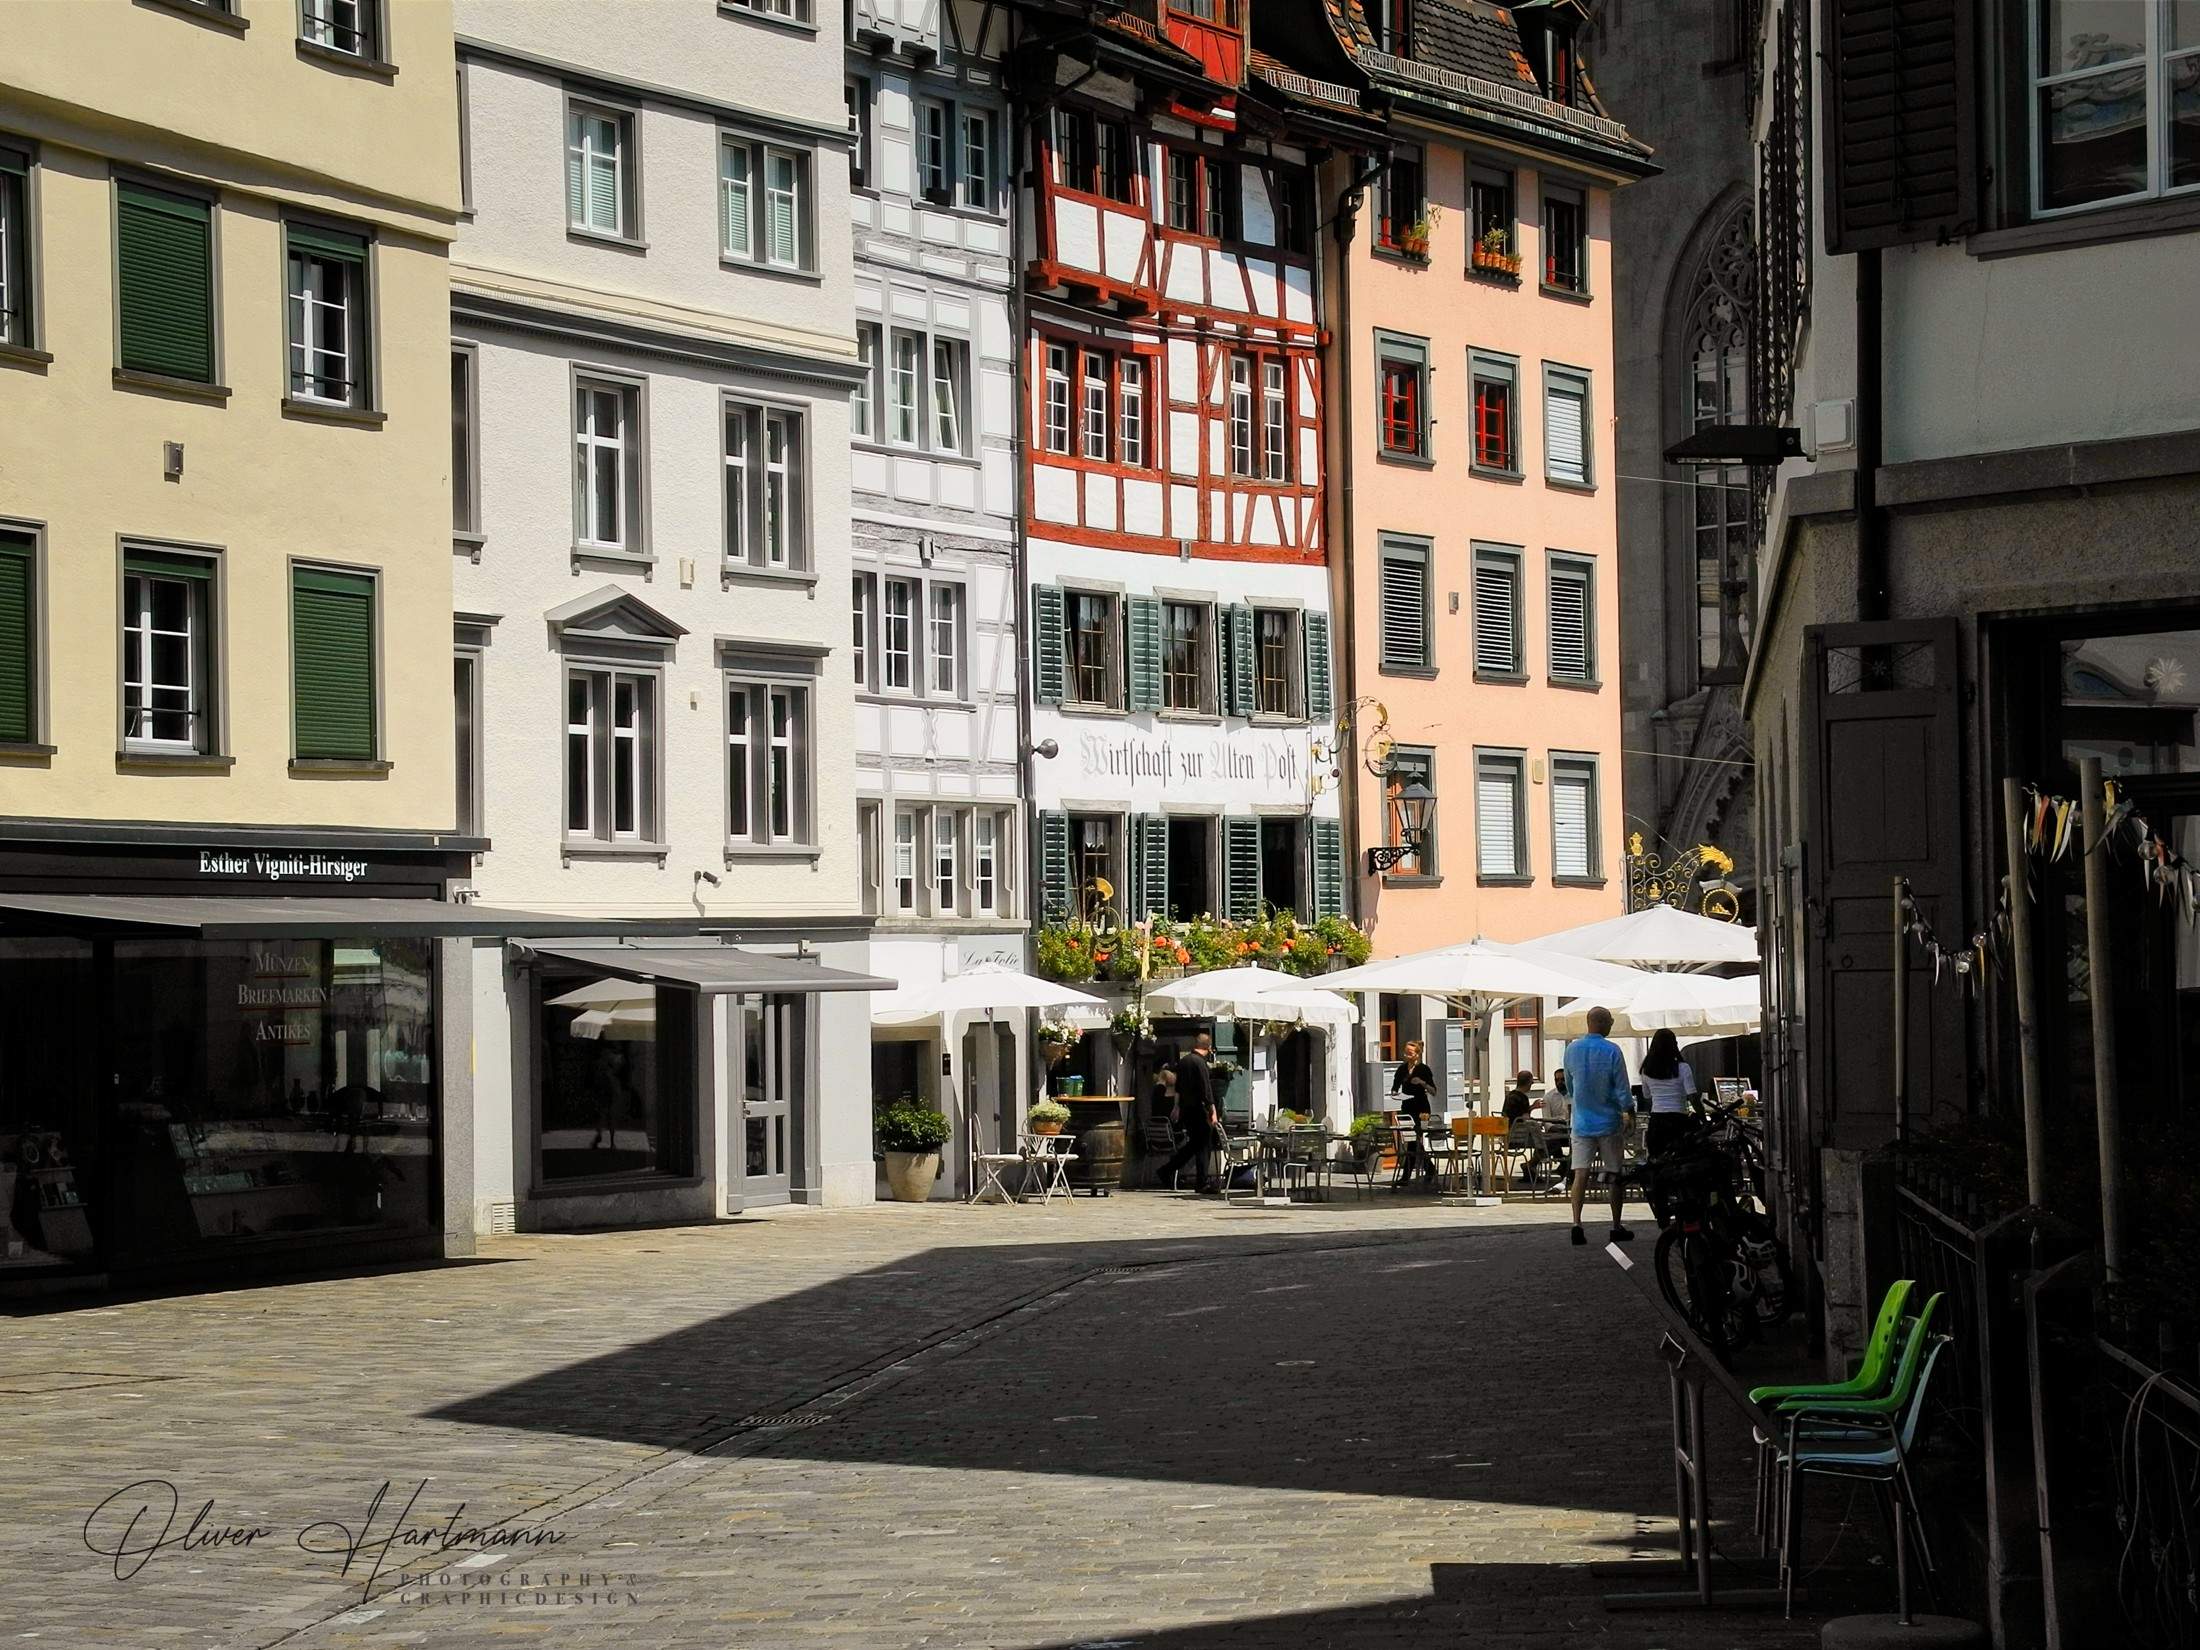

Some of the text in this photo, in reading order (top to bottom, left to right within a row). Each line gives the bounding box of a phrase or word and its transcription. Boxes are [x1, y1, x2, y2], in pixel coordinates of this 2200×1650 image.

[1181, 752, 1204, 786] zur
[1210, 741, 1254, 779] Alten
[1260, 742, 1297, 791] Post
[199, 850, 368, 881] Esther Vigniti-Hirsiger
[237, 984, 328, 1005] BRIEFMARKEN
[255, 1020, 312, 1041] ANTIKES
